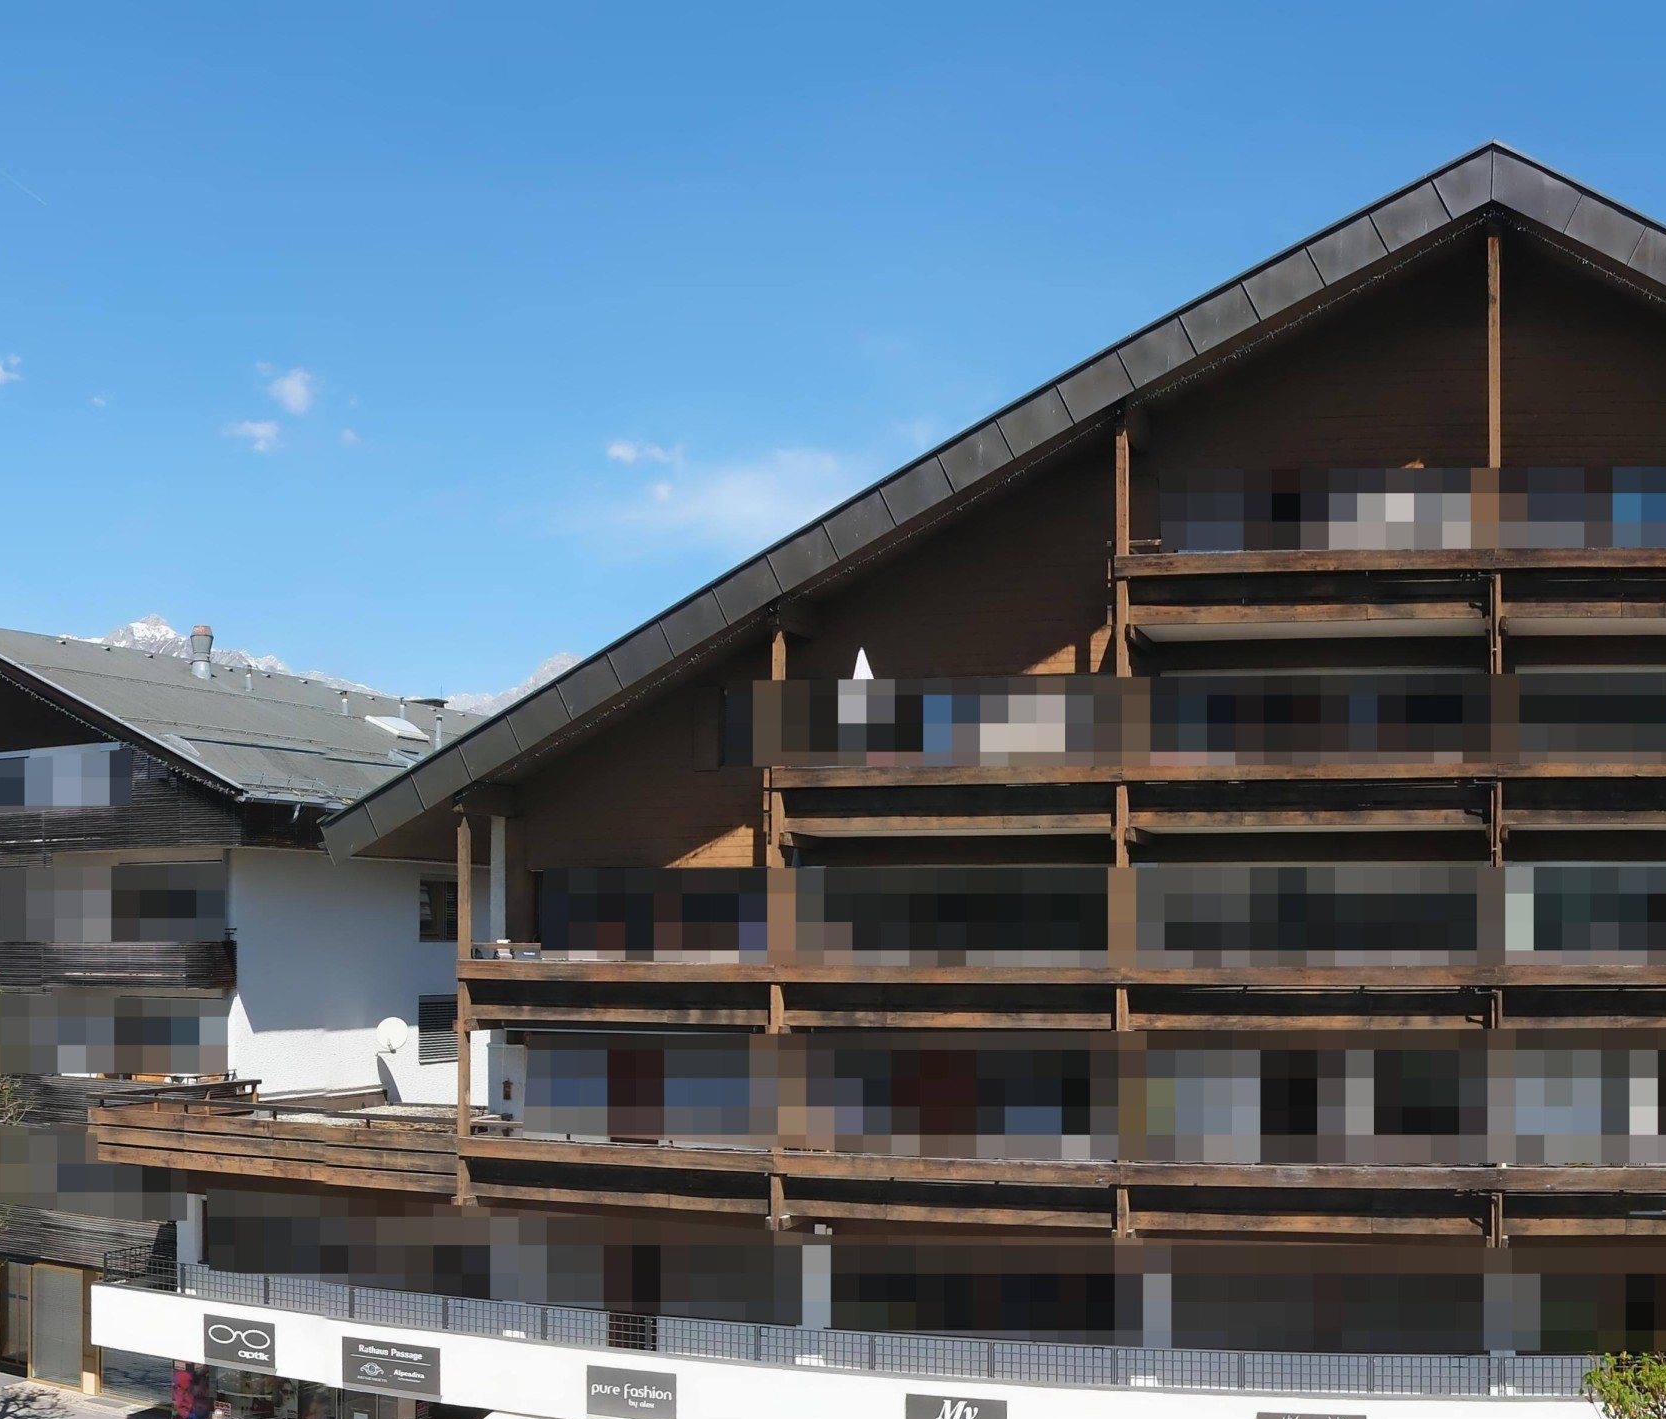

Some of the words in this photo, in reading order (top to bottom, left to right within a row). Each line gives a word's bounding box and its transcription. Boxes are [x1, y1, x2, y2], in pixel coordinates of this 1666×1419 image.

[238, 1349, 270, 1361] optik
[358, 1344, 389, 1356] Rathaus
[390, 1348, 423, 1361] Passage
[591, 1382, 621, 1396] pure
[623, 1383, 673, 1401] fashion
[628, 1399, 639, 1408] by
